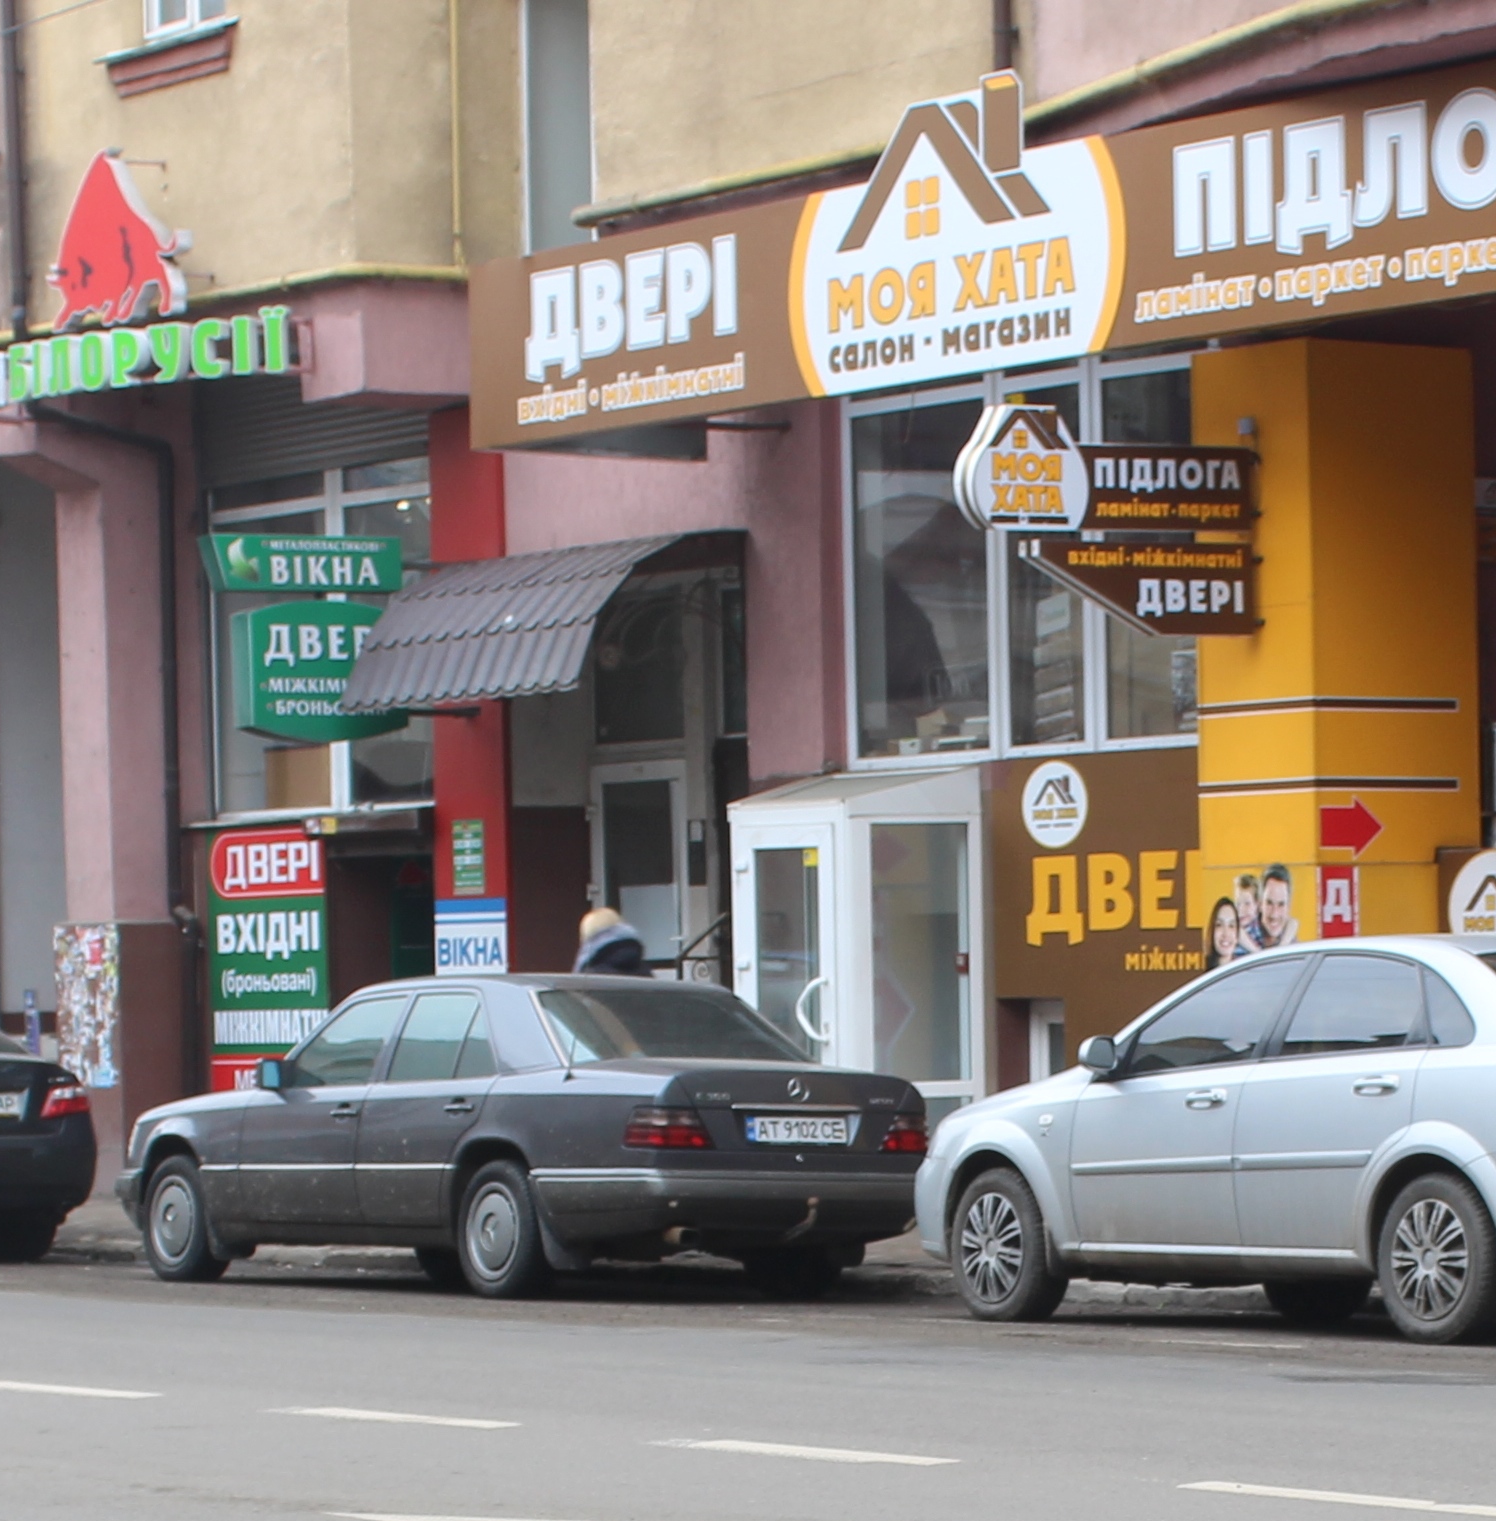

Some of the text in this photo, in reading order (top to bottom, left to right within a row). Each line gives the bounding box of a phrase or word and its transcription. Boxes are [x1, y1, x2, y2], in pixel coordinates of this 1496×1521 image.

[827, 236, 1076, 334] МОЯ ХАТА
[1134, 272, 1255, 323] ламінат
[1275, 254, 1385, 306] паркет
[524, 233, 738, 383] ДВЕРІ
[7, 305, 291, 400] БІЛОРУСІЇ
[828, 308, 1072, 373] салон магазин
[517, 352, 745, 425] вхідні міжкімнатні
[990, 452, 1063, 482] МОЯ
[1093, 457, 1241, 494] ПІДЛОГА
[990, 483, 1064, 513] ХАТА
[1095, 497, 1241, 523] ламінат паркет
[269, 555, 381, 587] ВІКНА
[1067, 546, 1244, 569] вхідні міжкімнатні
[1135, 578, 1245, 617] ДВЕРІ
[263, 623, 373, 668] ДВЕР
[268, 677, 347, 694] МІЖКІМ
[275, 699, 388, 717] БРОНЬО
[223, 839, 321, 891] ДВЕРІ
[216, 910, 321, 961] ВХІДНІ
[437, 937, 504, 968] ВІКНА
[1124, 945, 1204, 971] міжкім
[221, 966, 319, 999] (броньовані)
[758, 1120, 845, 1140] AT 9102 CE
